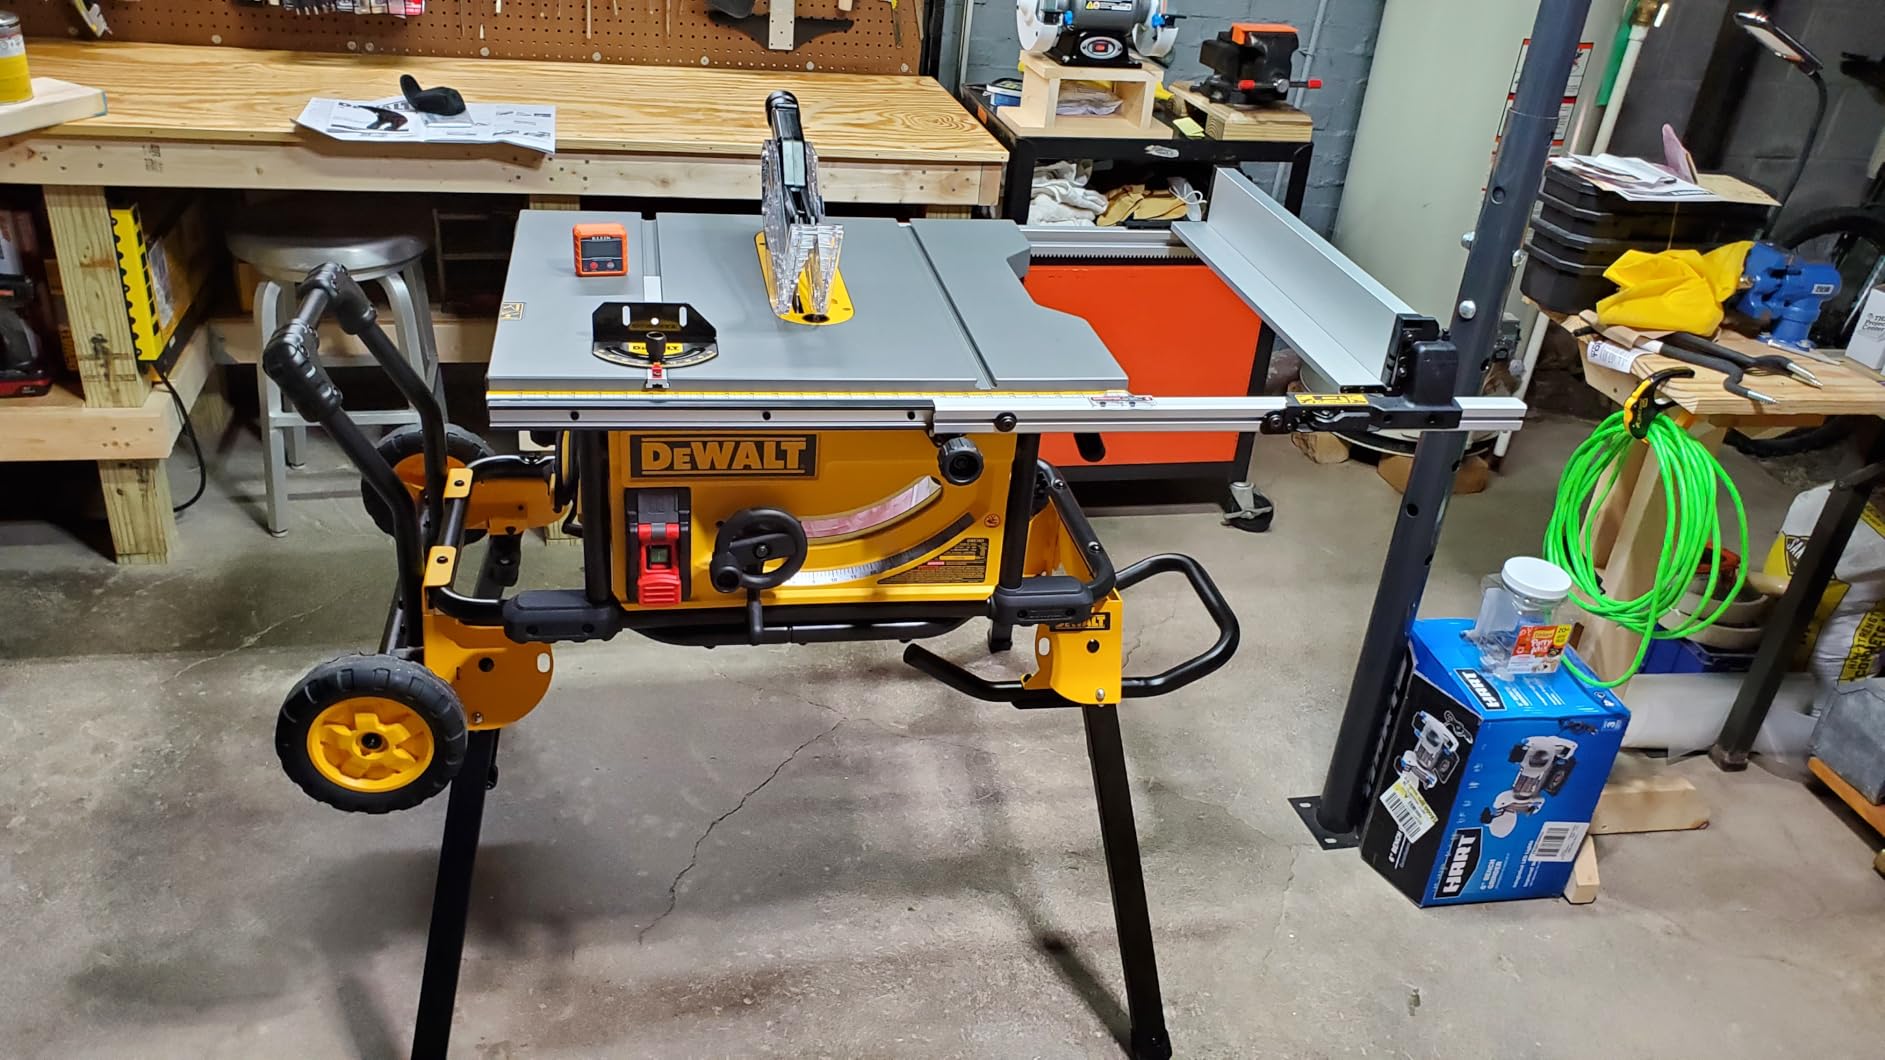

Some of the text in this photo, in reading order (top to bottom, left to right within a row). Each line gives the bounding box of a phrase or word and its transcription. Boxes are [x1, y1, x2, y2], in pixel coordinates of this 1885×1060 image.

[641, 441, 806, 471] DEWALT
[1462, 671, 1500, 708] HART
[1442, 834, 1477, 893] HART
